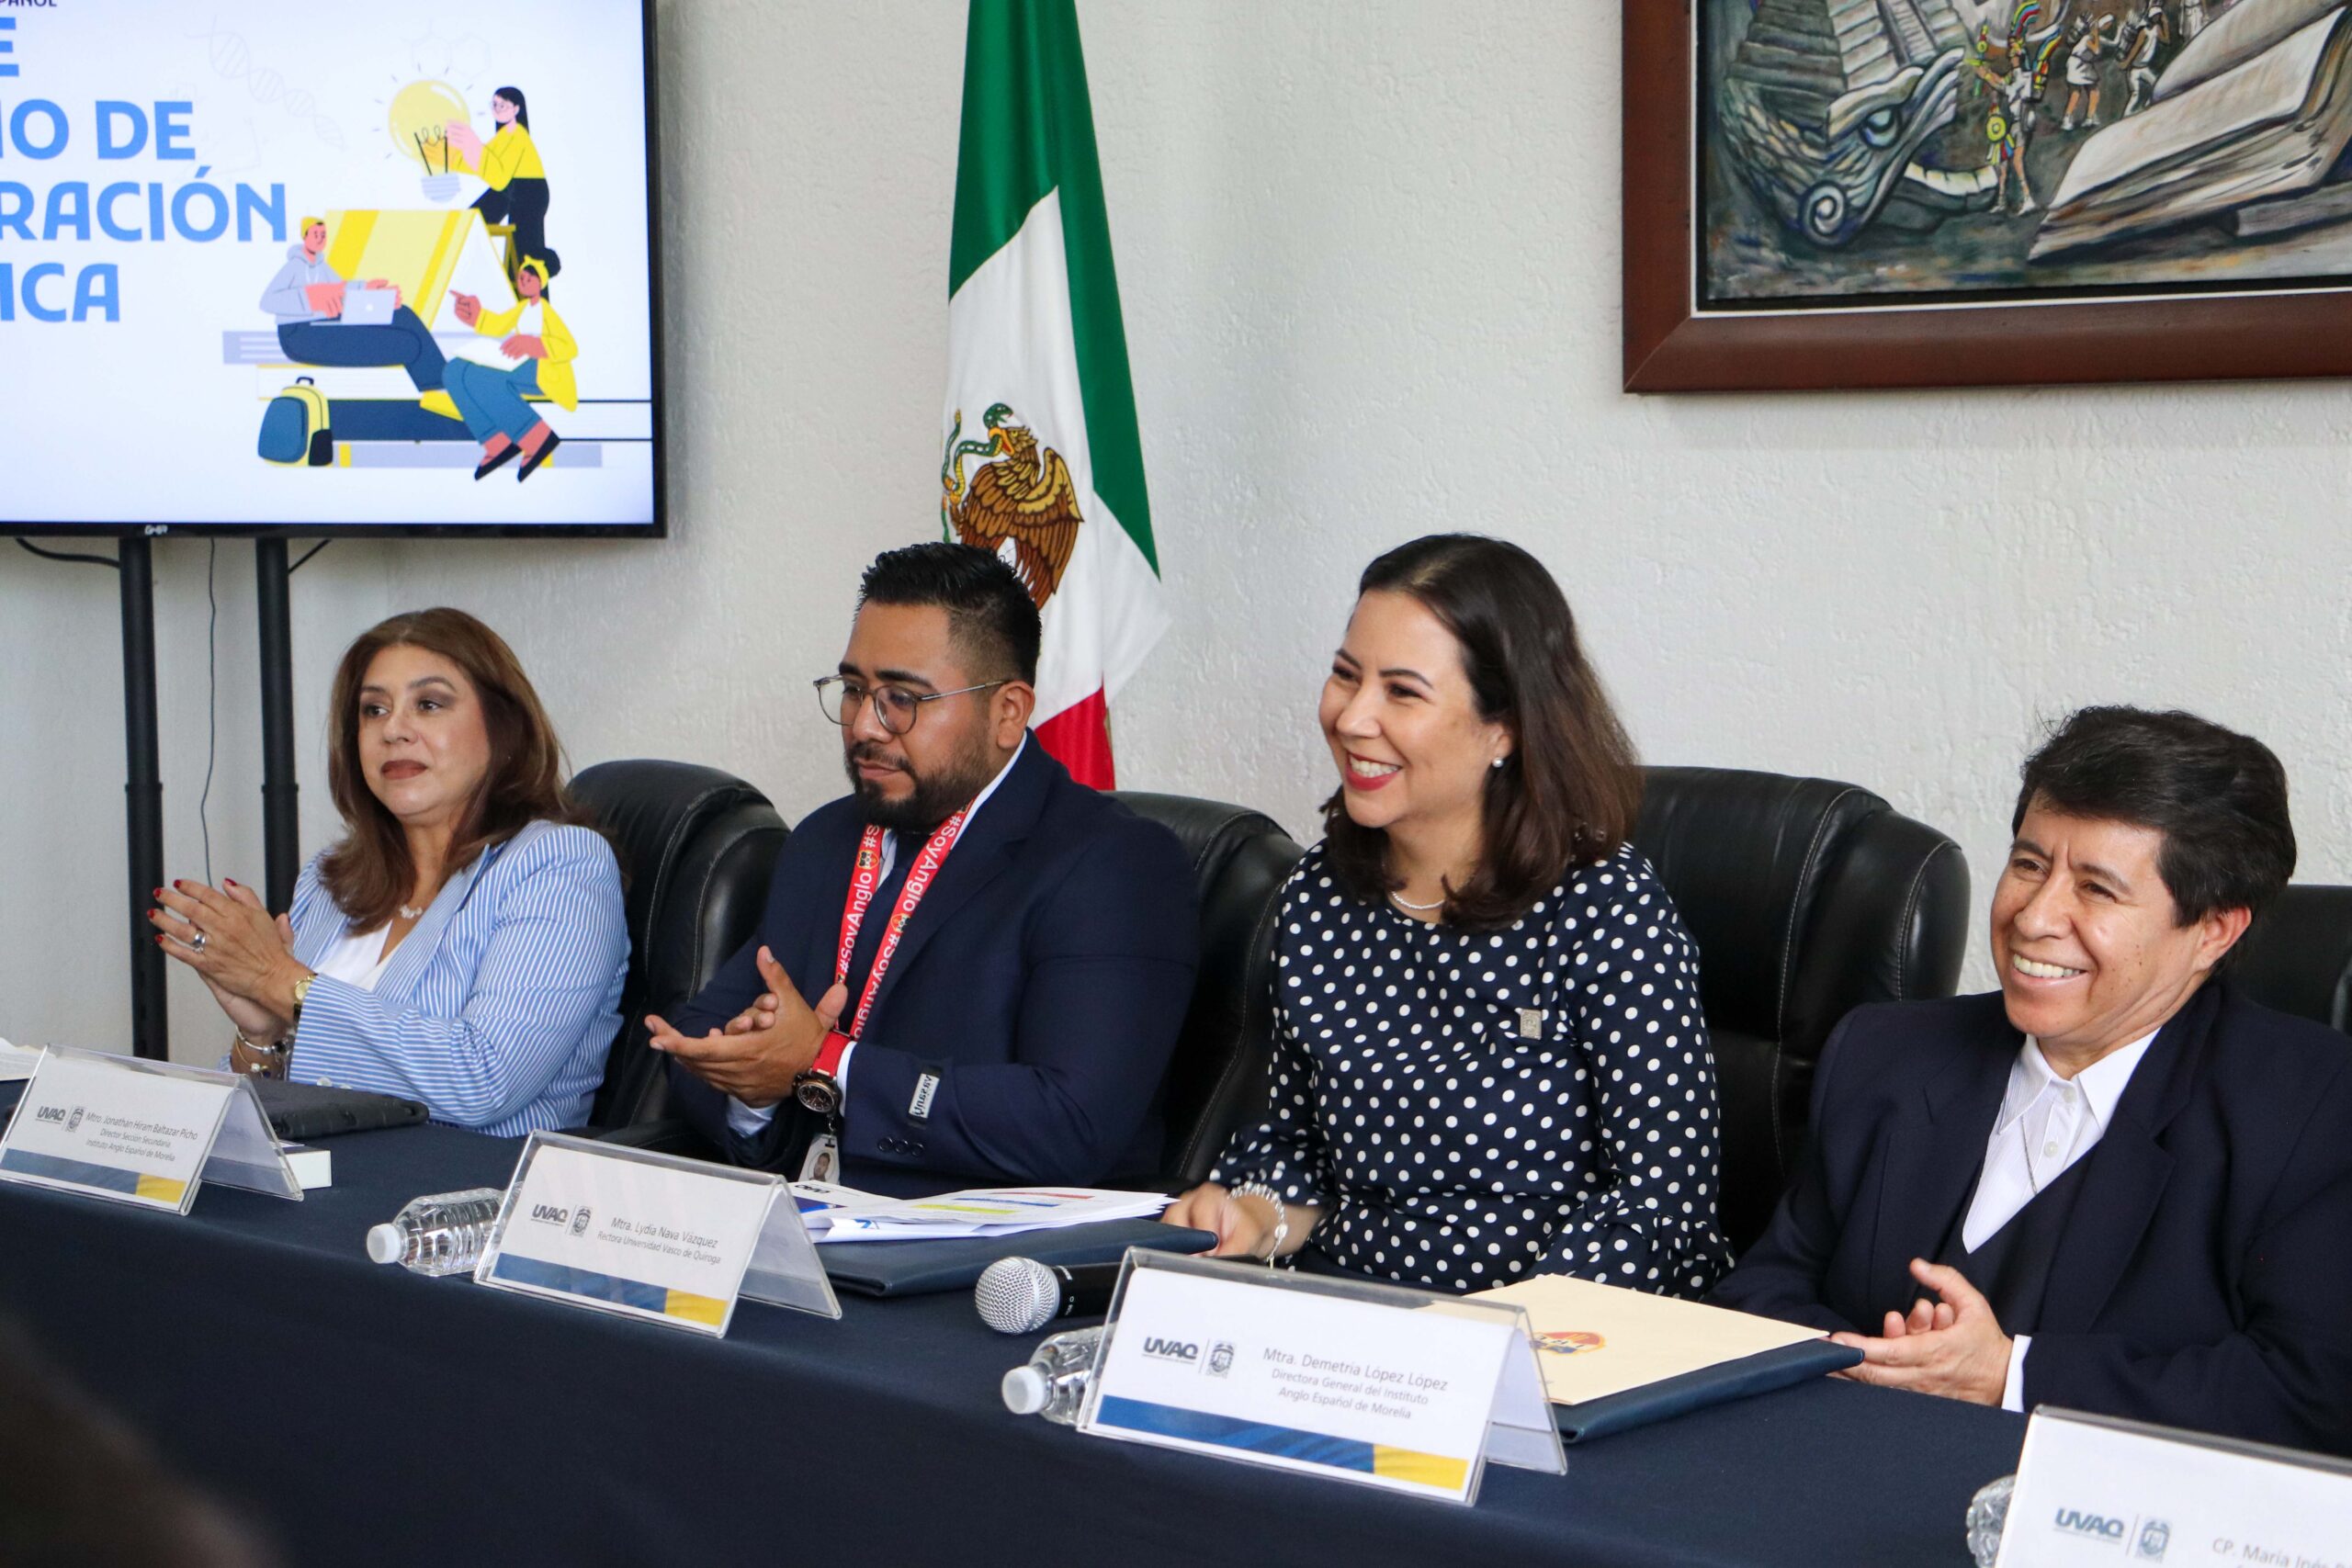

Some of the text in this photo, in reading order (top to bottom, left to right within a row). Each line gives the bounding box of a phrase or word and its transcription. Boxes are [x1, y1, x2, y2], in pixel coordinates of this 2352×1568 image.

[95, 99, 196, 161] DE
[0, 165, 287, 243] RACIÓN
[902, 815, 962, 912] #SoyAnglo
[38, 1106, 66, 1121] UVAQ
[103, 1116, 133, 1128] Jonathan
[532, 1204, 569, 1223] UVAQ
[611, 1217, 632, 1231] Mtra.
[635, 1222, 657, 1235] Lydia
[659, 1226, 680, 1240] Nava
[597, 1231, 622, 1244] Rectora
[623, 1236, 662, 1251] Universidad
[662, 1244, 682, 1256] Vasco
[683, 1248, 693, 1258] de
[694, 1250, 721, 1265] Quiroga
[1143, 1337, 1198, 1359] UVAQ
[1262, 1348, 1448, 1392] Mtra. Demetria López López
[1272, 1368, 1429, 1405] Directora General del Instituto
[1278, 1386, 1411, 1420] Anglo Español de Morelia
[2055, 1507, 2124, 1539] UVAQ
[2212, 1537, 2235, 1556] CP.
